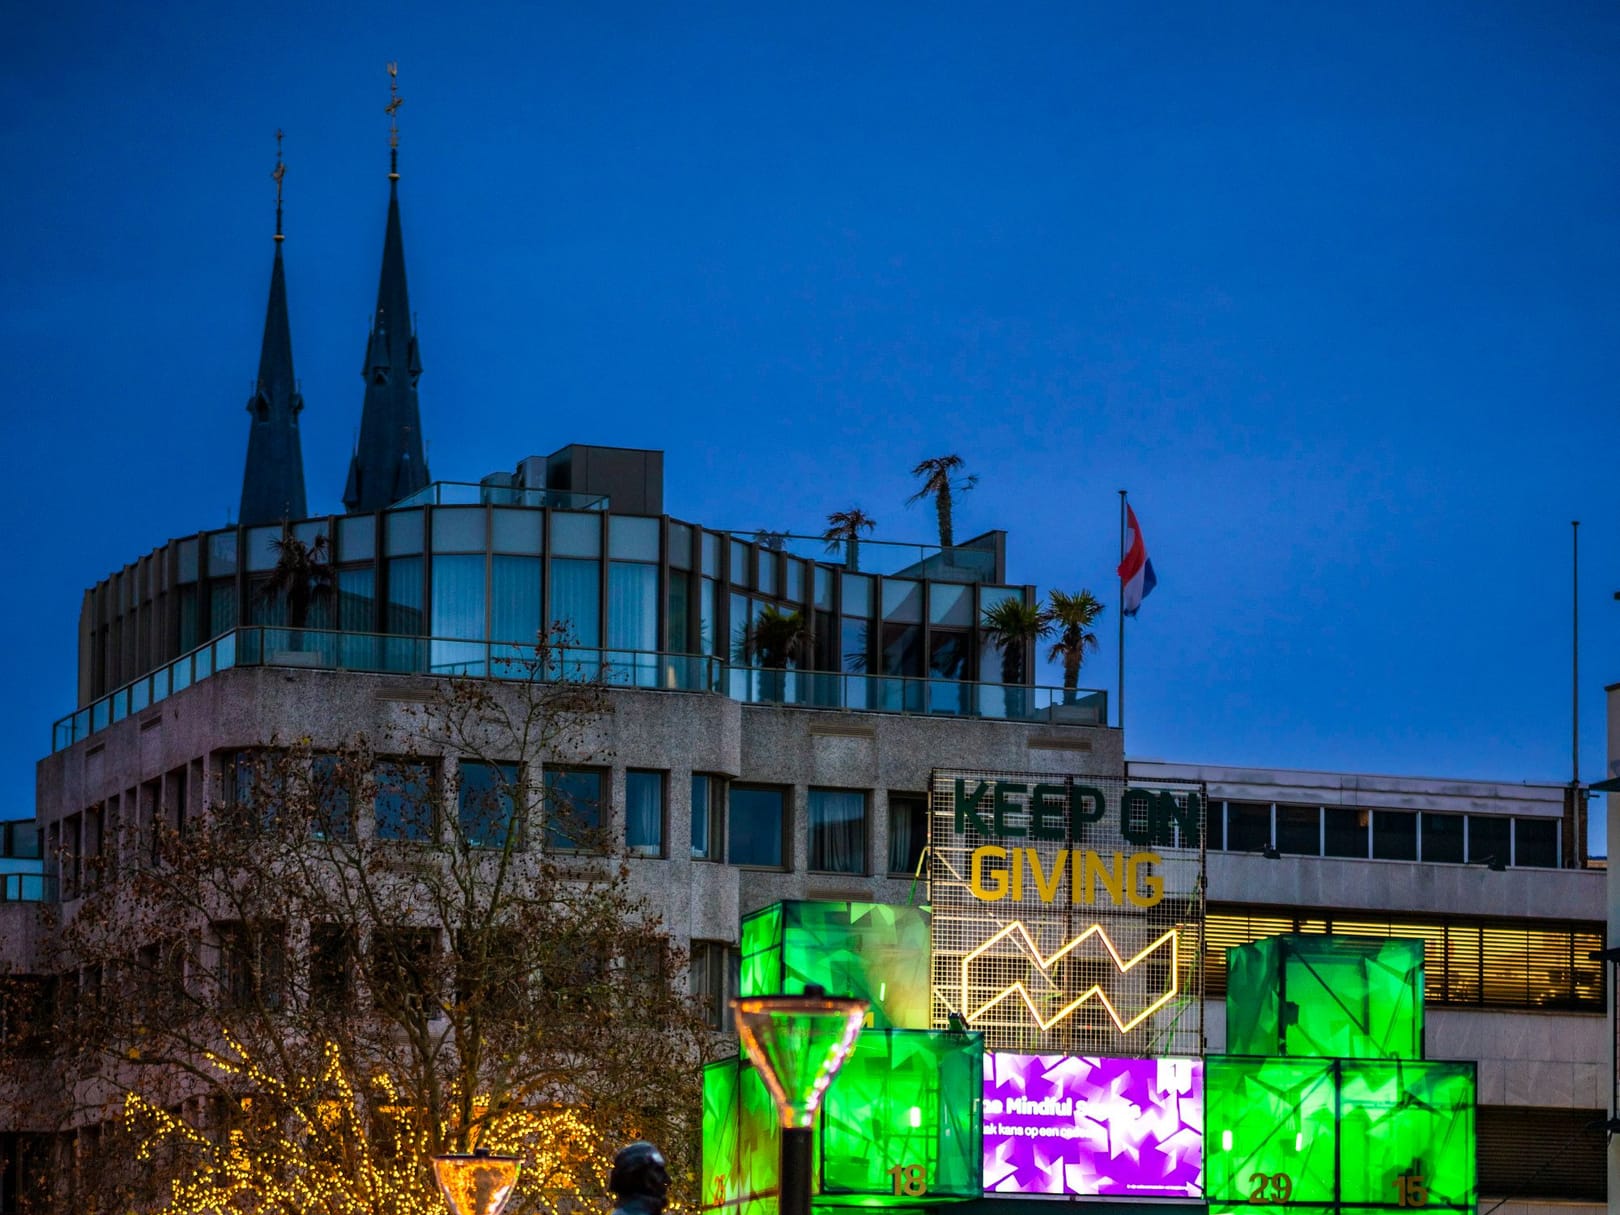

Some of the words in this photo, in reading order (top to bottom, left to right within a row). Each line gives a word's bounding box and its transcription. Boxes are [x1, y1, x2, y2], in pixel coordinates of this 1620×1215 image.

[954, 778, 1105, 841] KEEP
[1121, 790, 1199, 846] ON
[971, 845, 1164, 907] GIVING
[1006, 1095, 1072, 1117] Mindful
[1024, 1127, 1038, 1139] op
[888, 1163, 927, 1197] 18
[1248, 1172, 1292, 1204] 29
[1392, 1175, 1428, 1208] 15
